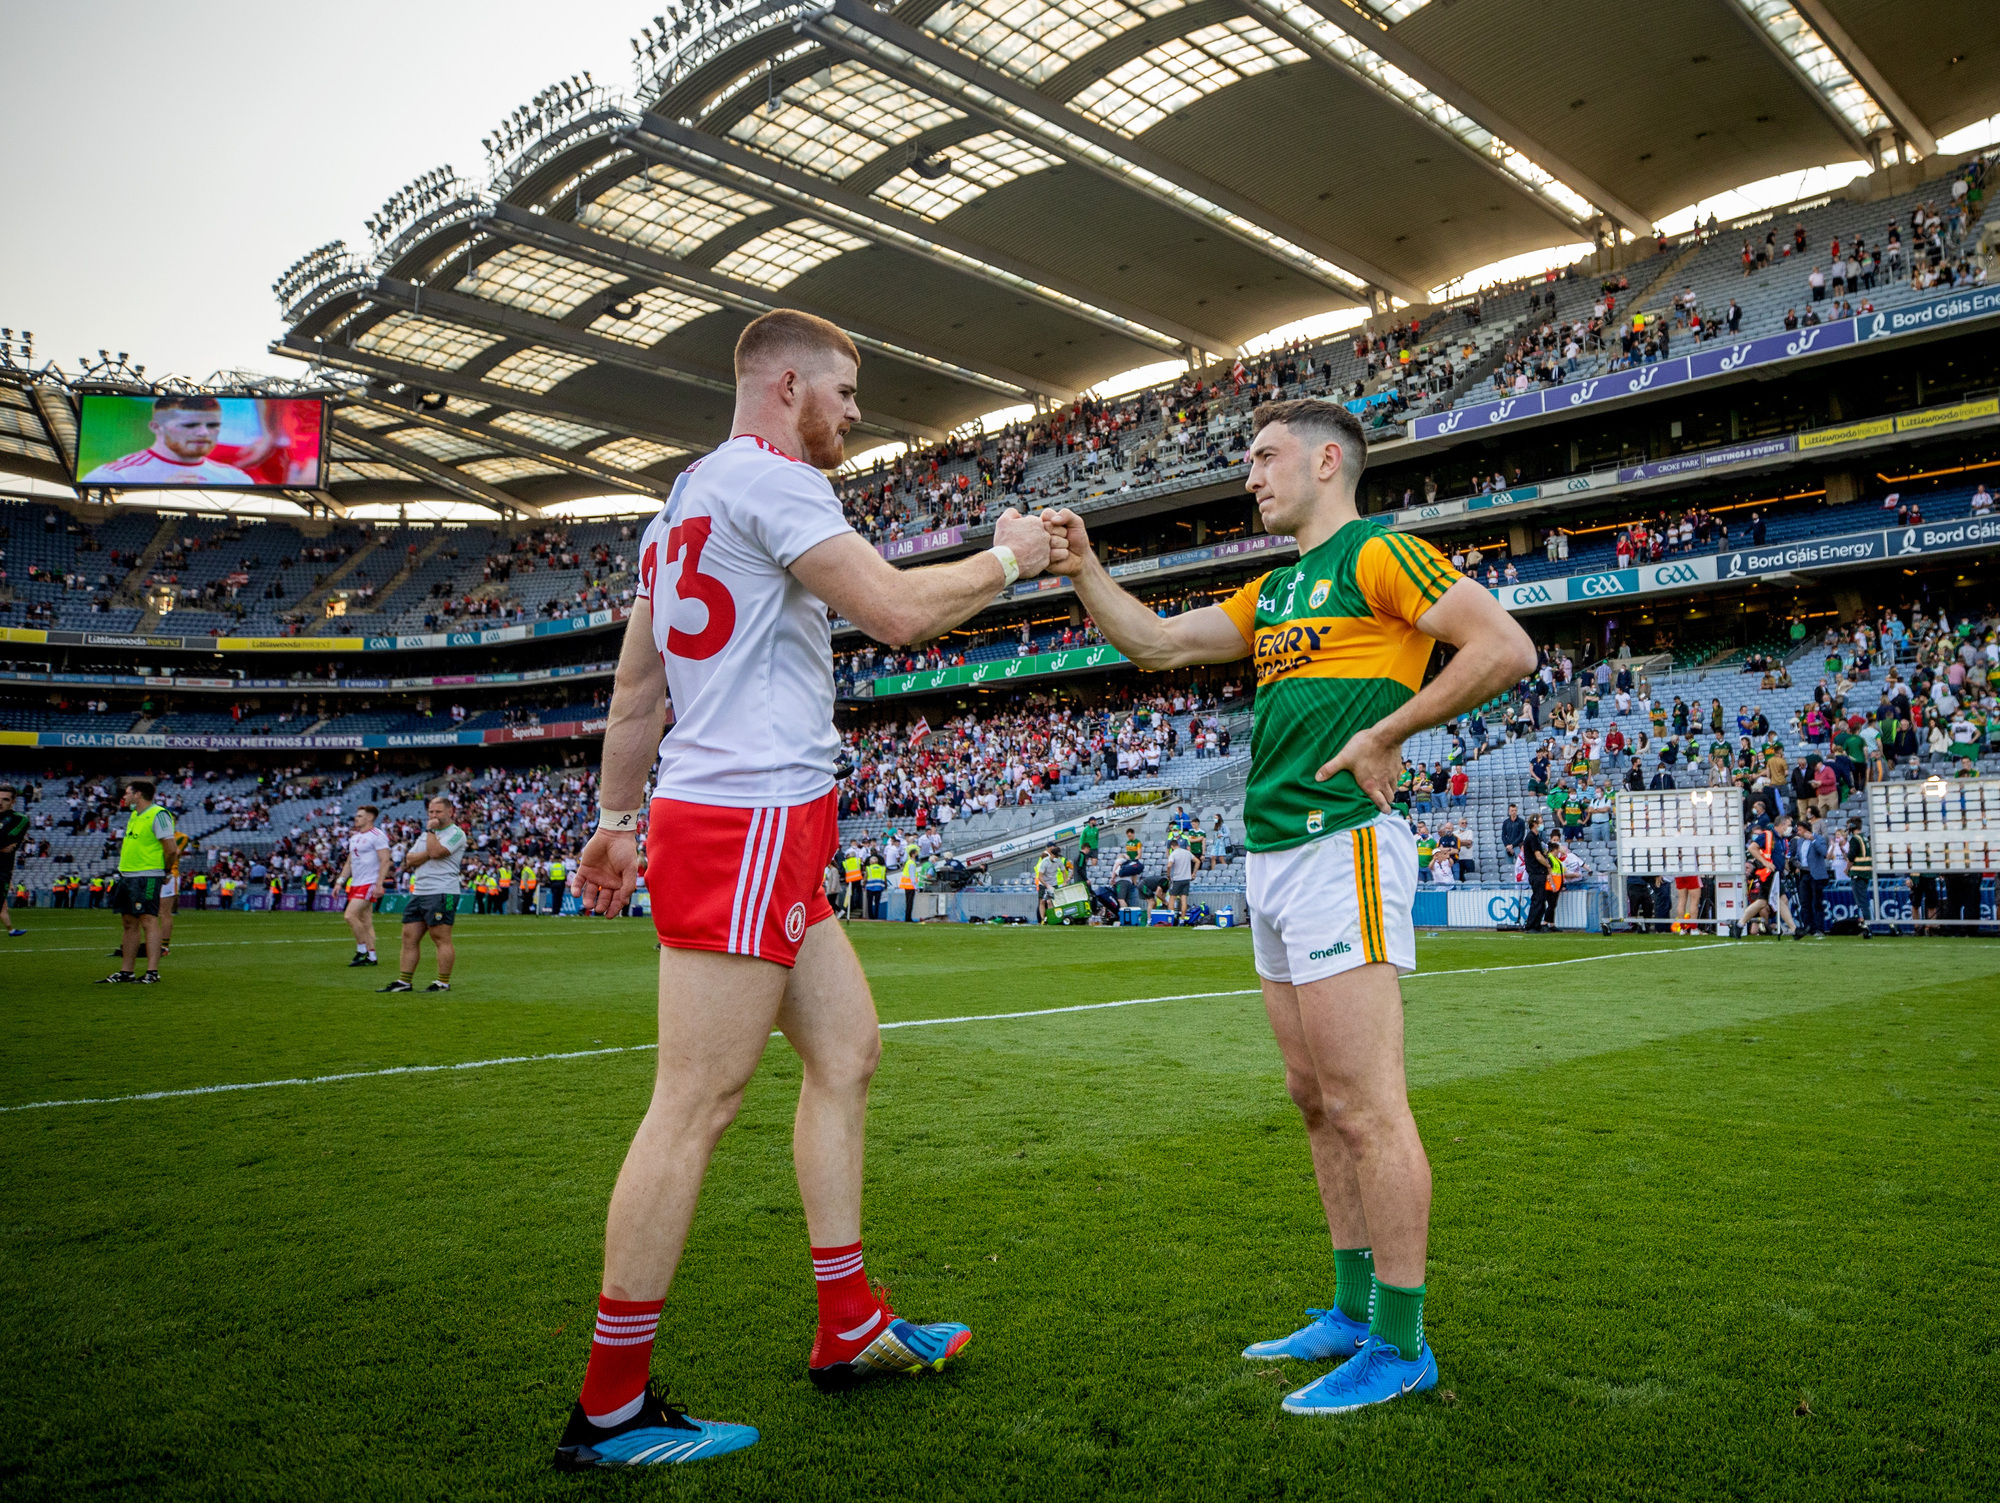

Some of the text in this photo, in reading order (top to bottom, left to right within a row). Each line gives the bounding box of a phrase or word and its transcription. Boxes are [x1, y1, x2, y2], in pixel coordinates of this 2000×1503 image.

[1893, 306, 1932, 328] Bord
[1935, 298, 1971, 320] Gáis
[1787, 328, 1820, 356] eir
[1720, 344, 1752, 370] eir
[1629, 367, 1658, 391] eir
[1570, 380, 1599, 405] eir
[1490, 400, 1516, 423] eir
[1438, 411, 1464, 434] eir
[1706, 442, 1785, 464] MEETINGS & EVENTS
[1658, 459, 1700, 474] CROKE PARK
[1567, 477, 1590, 491] GAA
[1491, 492, 1514, 505] GAA
[1420, 506, 1440, 518] GAA
[931, 532, 949, 547] AIB
[1924, 521, 2000, 546] Bord Gáis
[897, 540, 914, 555] AIB
[1226, 544, 1239, 554] AIB
[1252, 540, 1265, 549] AIB
[1748, 540, 1874, 570] Bord Gáis Energy
[1655, 563, 1699, 586] GAA
[1582, 574, 1624, 596] GAA
[1513, 585, 1552, 605] GAA
[1051, 652, 1068, 671] eir
[1086, 647, 1104, 666] eir
[972, 664, 989, 681] eir
[1005, 659, 1022, 677] eir
[902, 675, 916, 692] eir
[930, 670, 946, 688] eir
[66, 734, 114, 746] GAA.ie
[116, 735, 164, 747] GAA.ie
[165, 736, 363, 747] CROKE PARK MEETINGS & EVENTS
[388, 733, 458, 746] GAA MUSEUM
